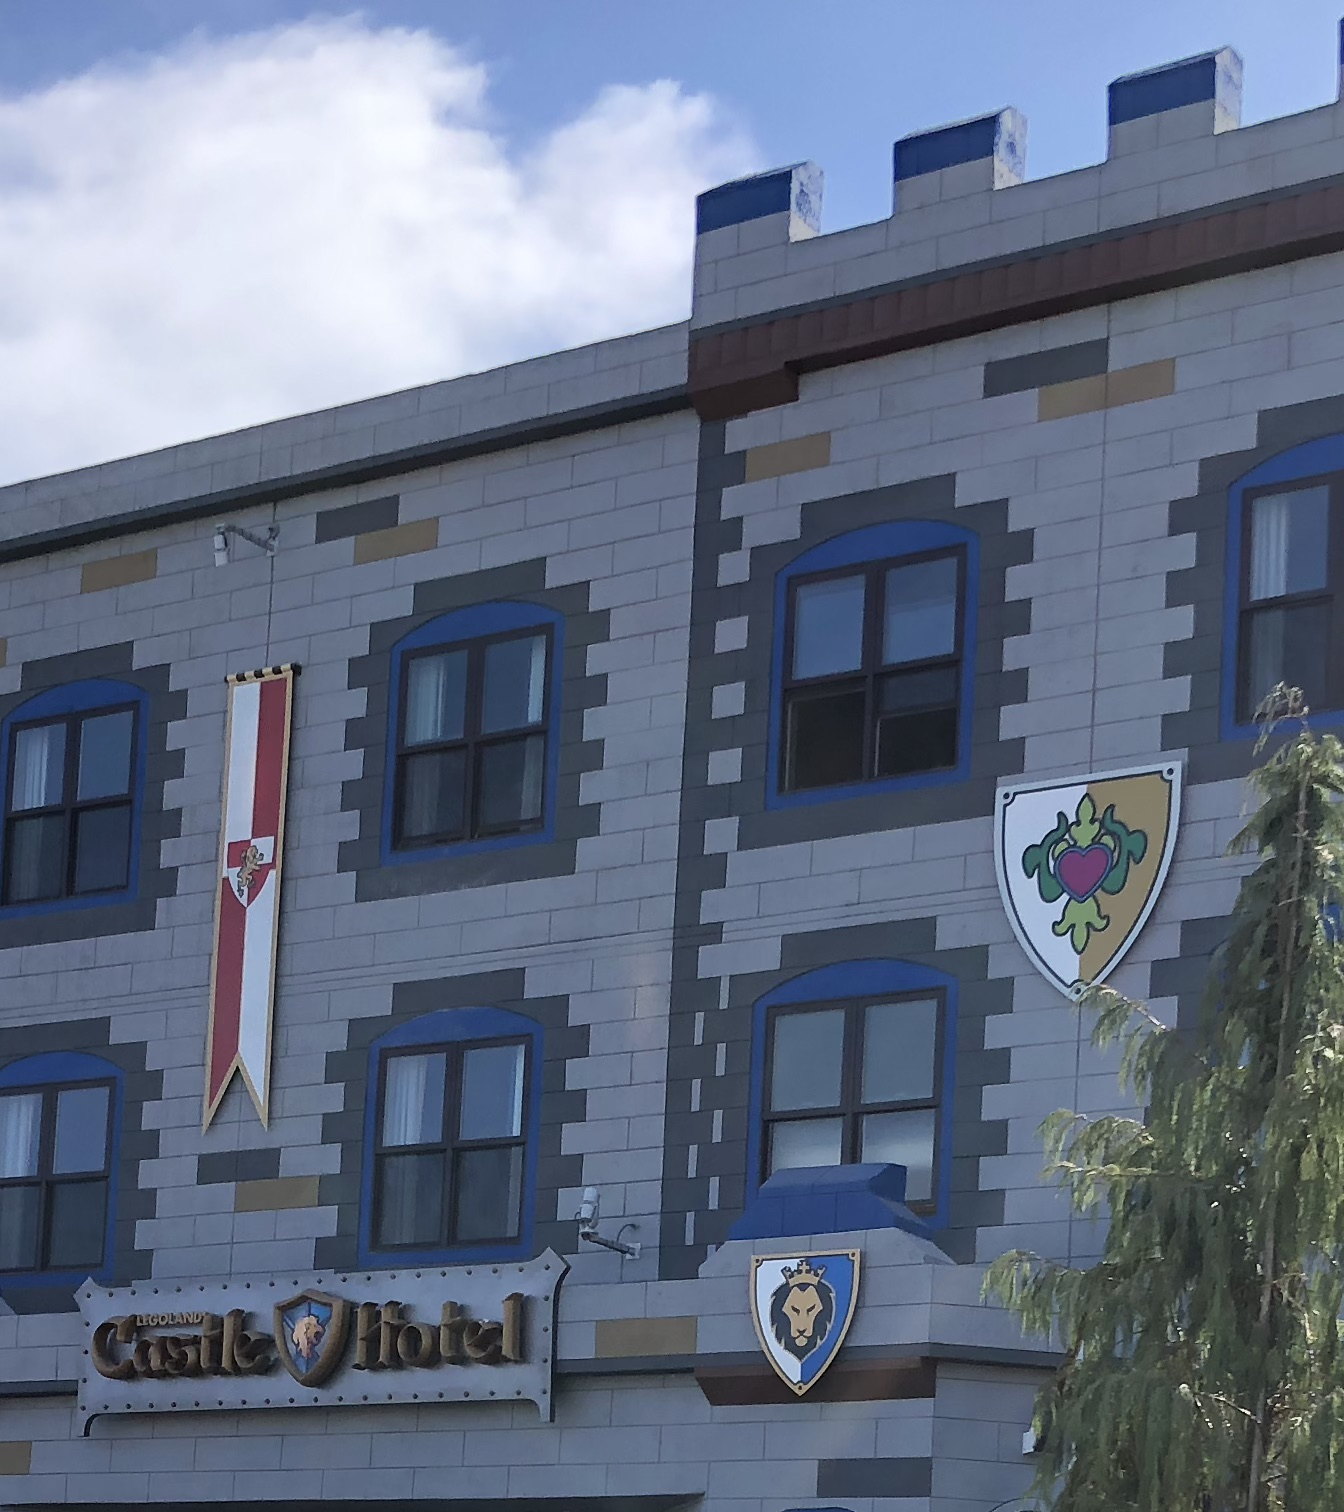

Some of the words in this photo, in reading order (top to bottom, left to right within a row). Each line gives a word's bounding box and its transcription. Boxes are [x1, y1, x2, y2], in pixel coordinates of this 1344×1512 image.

[92, 1308, 274, 1379] Castle
[352, 1292, 524, 1370] Hotel
[136, 1312, 203, 1327] LEGOLAND
